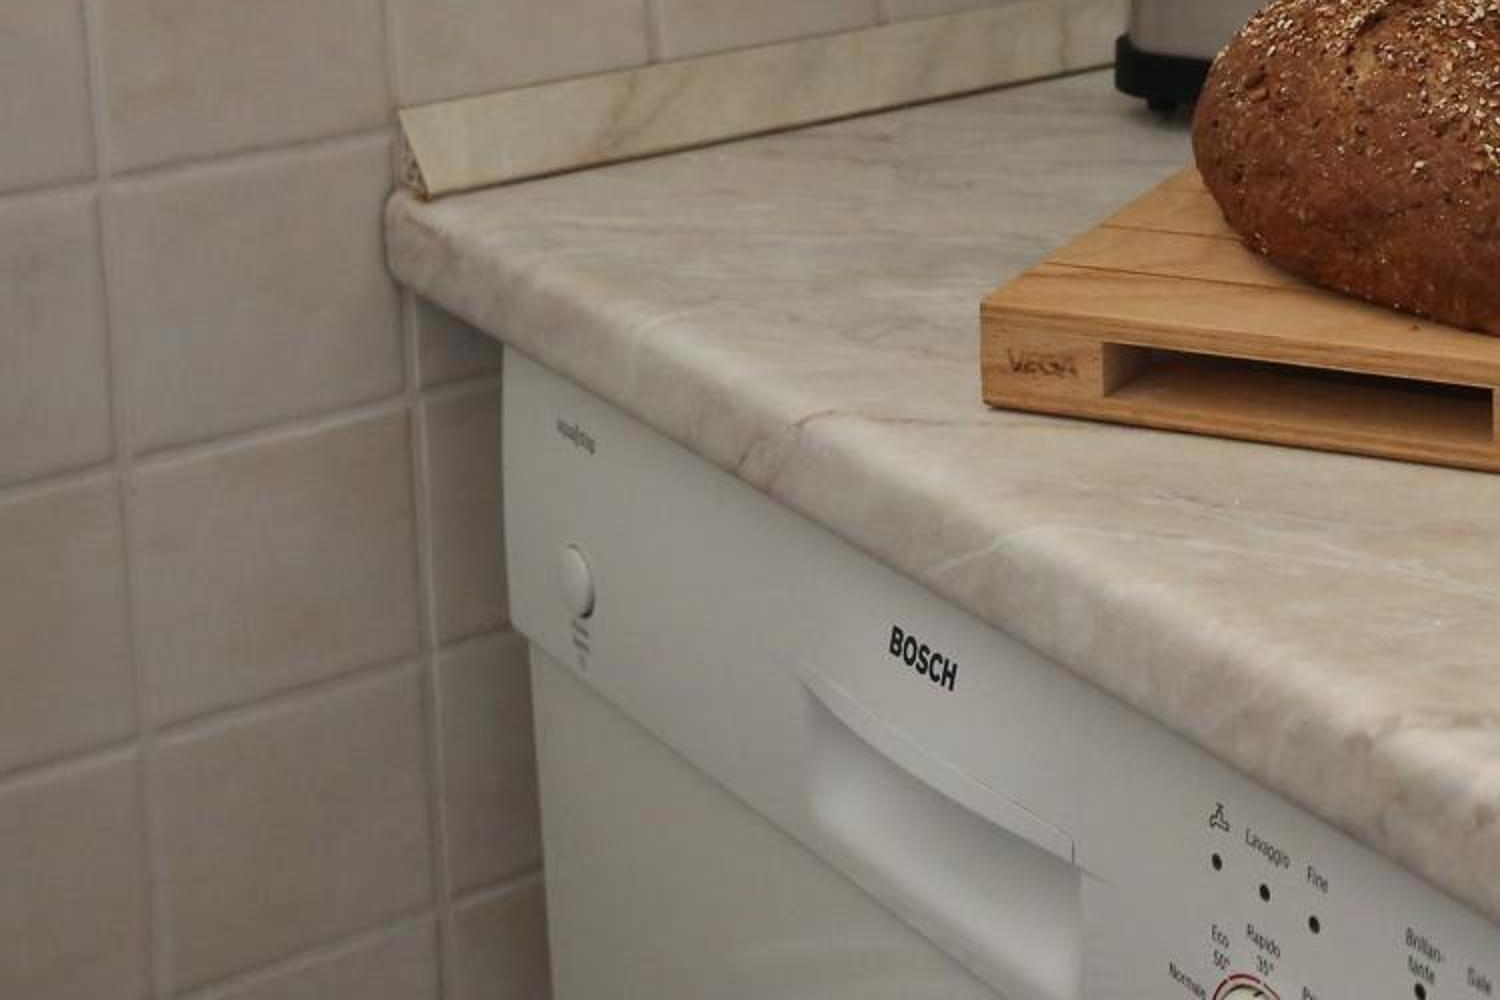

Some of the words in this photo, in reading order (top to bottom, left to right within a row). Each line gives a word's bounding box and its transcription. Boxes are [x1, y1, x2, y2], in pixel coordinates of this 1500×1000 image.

[889, 625, 958, 690] BOSCH
[1245, 828, 1290, 869] Lavaggio
[1306, 864, 1329, 894] Fine
[1211, 923, 1229, 949] Eco
[1246, 921, 1281, 960] Rapido
